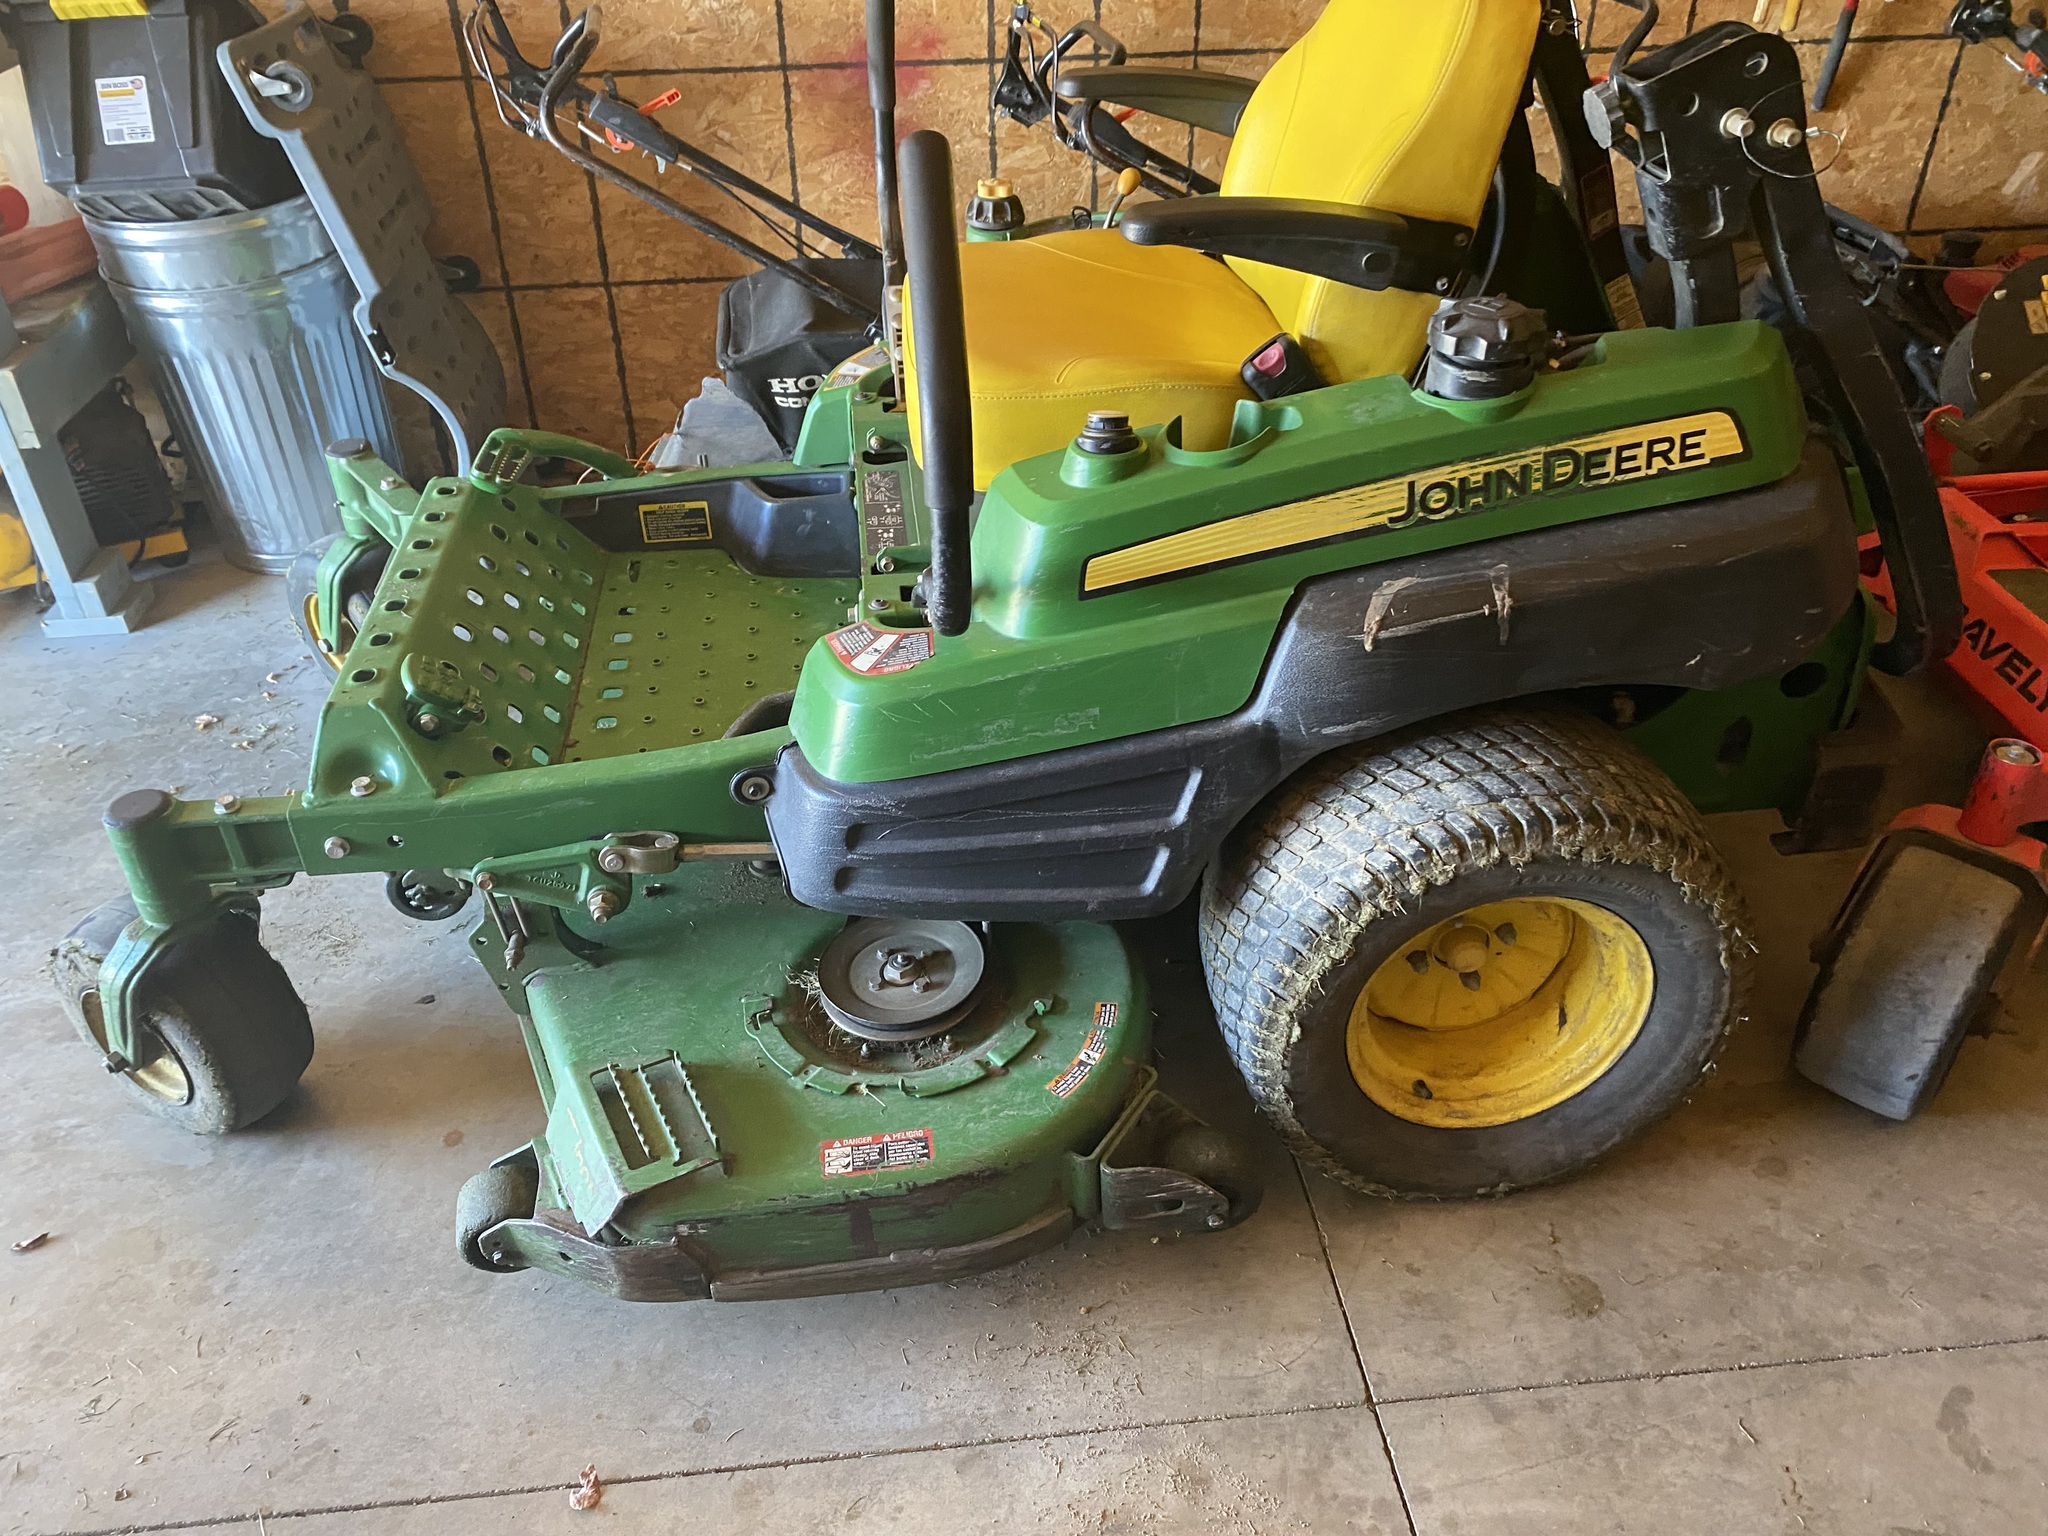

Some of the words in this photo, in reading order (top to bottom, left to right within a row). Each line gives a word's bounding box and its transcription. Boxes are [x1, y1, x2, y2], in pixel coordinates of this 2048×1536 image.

[767, 374, 828, 393] HO
[1387, 463, 1530, 526] JOHN
[1541, 429, 1708, 492] DEERE
[1961, 605, 2048, 712] AVEL
[842, 1136, 873, 1146] DANGER
[892, 1129, 924, 1140] PELIGRO
